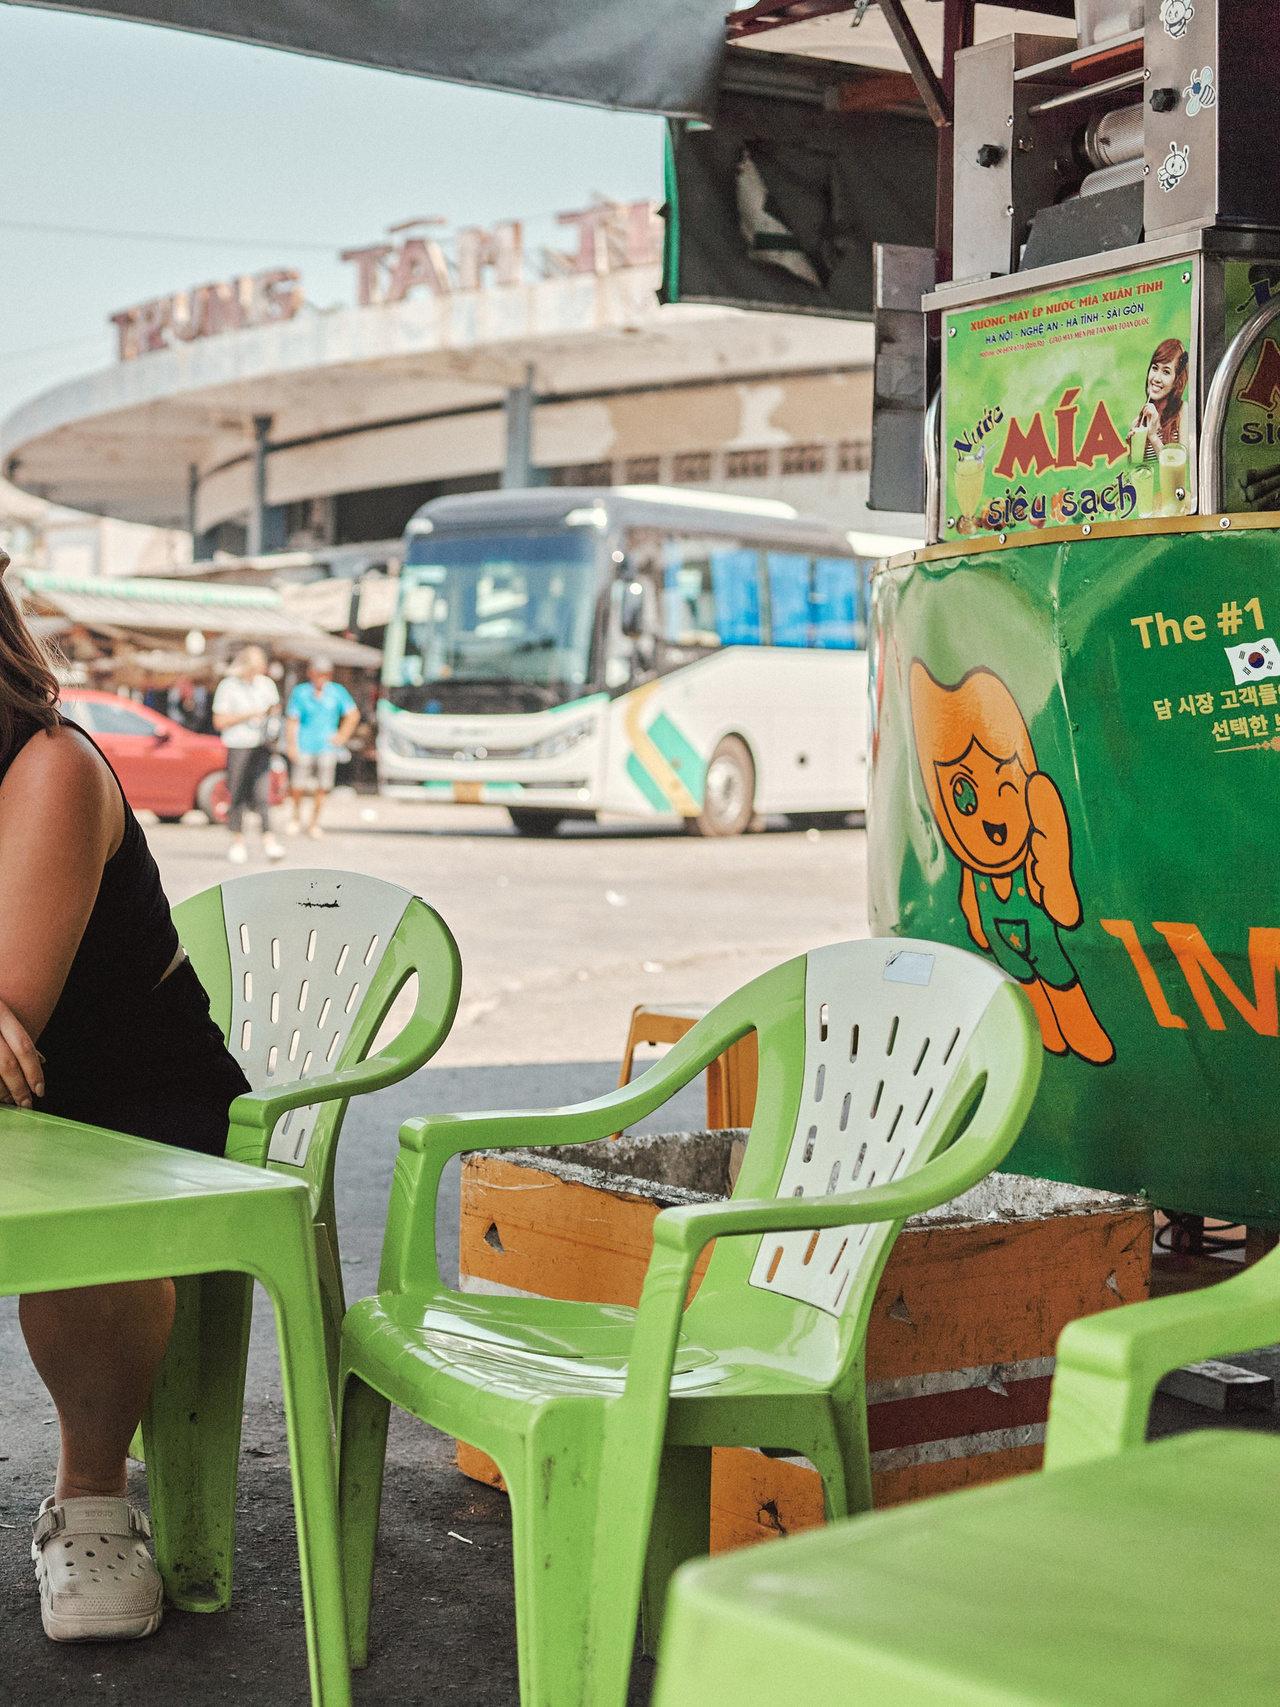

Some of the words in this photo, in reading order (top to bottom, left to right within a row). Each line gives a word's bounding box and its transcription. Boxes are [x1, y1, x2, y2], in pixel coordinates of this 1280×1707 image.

[985, 333, 997, 344] HÀ
[999, 329, 1013, 342] NỘI
[1020, 323, 1044, 337] NGHỆ
[1046, 321, 1059, 331] AN
[1066, 316, 1078, 327] HÀ
[1106, 307, 1121, 320] SÀI
[1122, 302, 1144, 316] GÒN
[1008, 308, 1030, 323] MÁY
[1032, 306, 1044, 319] ÉP
[1045, 299, 1076, 315] NƯỚC
[1078, 293, 1099, 308] MÍA
[1101, 285, 1133, 303] XUÂN
[953, 405, 1004, 461] Nước
[994, 387, 1128, 479] MÍA
[987, 485, 1046, 525] siêu
[1061, 471, 1137, 521] sạch
[1130, 611, 1207, 649] The
[1217, 597, 1265, 636] #1
[1153, 698, 1172, 721] 담
[1178, 692, 1214, 716] 시장
[1220, 683, 1280, 709] 고객들
[1211, 714, 1269, 742] 선택한
